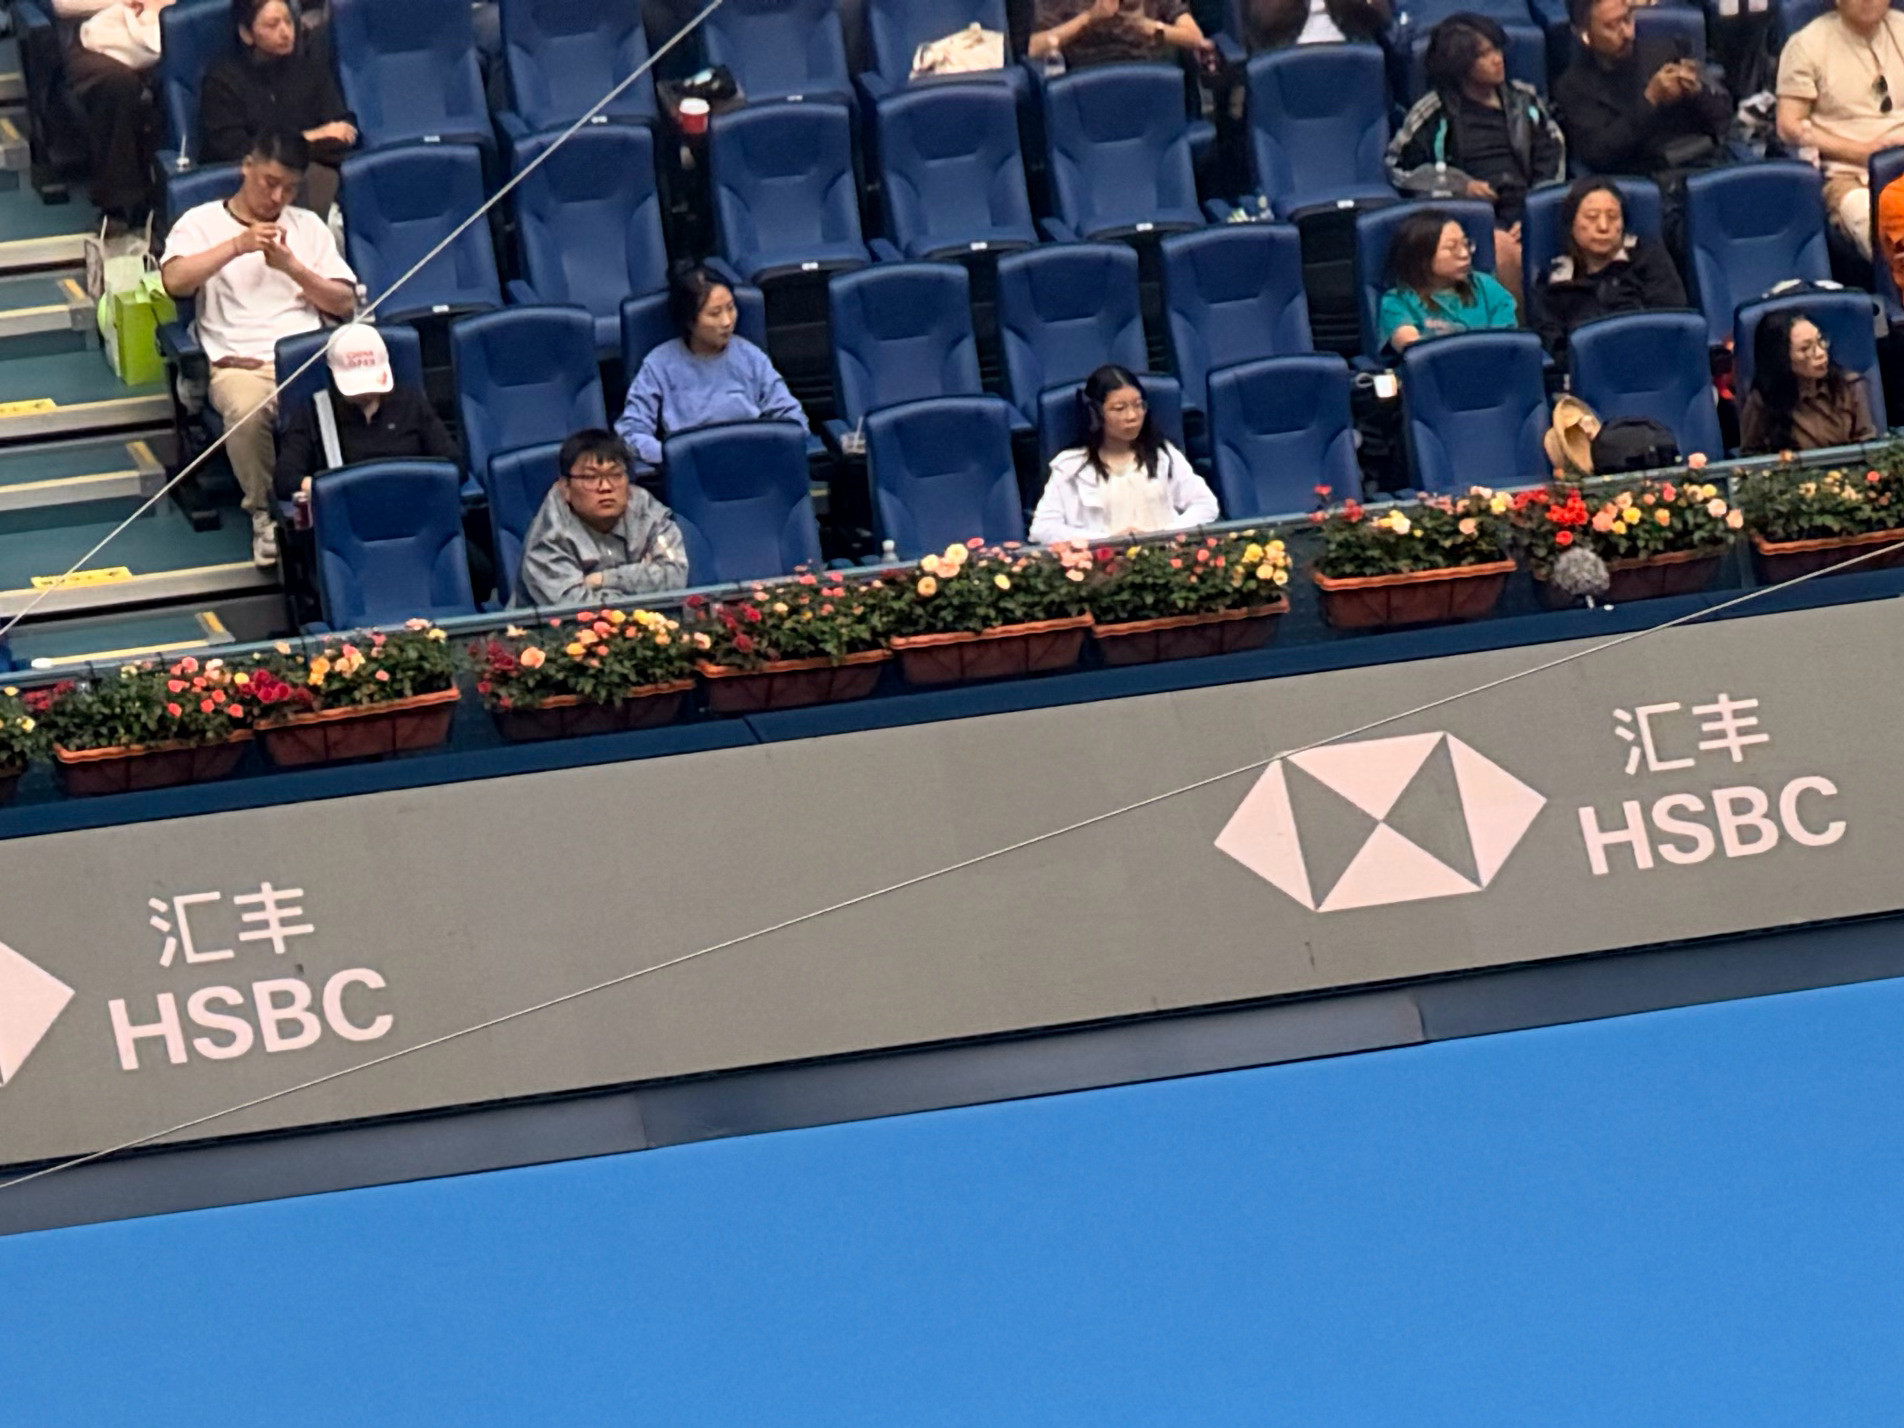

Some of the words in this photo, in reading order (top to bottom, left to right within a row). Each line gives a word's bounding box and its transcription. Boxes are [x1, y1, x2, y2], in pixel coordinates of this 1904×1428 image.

[1614, 693, 1770, 776] 汇丰
[1578, 776, 1846, 876] HSBC
[149, 882, 314, 967] 汇丰
[108, 968, 393, 1070] HSBC
